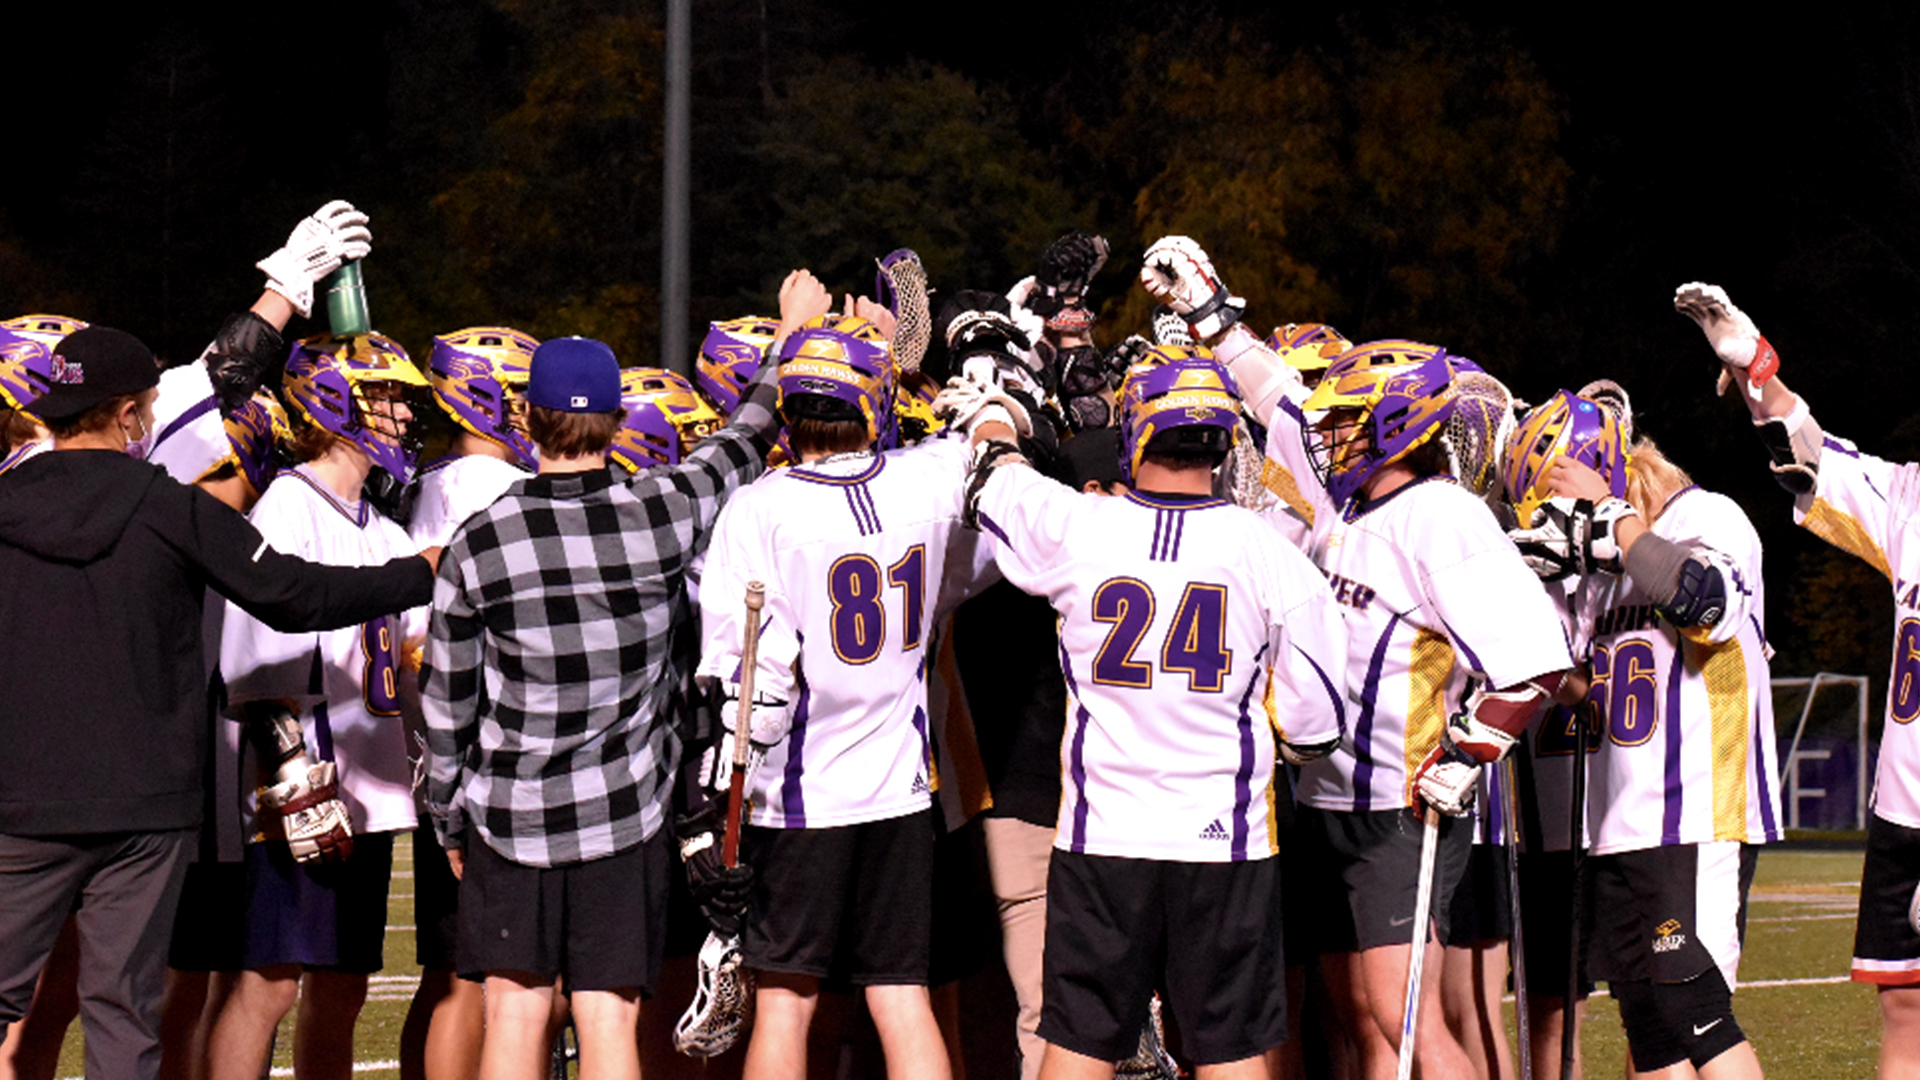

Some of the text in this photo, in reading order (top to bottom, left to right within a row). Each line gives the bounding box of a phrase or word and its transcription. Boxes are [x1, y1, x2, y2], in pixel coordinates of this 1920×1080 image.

[783, 362, 819, 374] GOLDEN
[1155, 395, 1199, 410] GOLDEN
[827, 543, 926, 666] 81
[1091, 576, 1233, 693] 24
